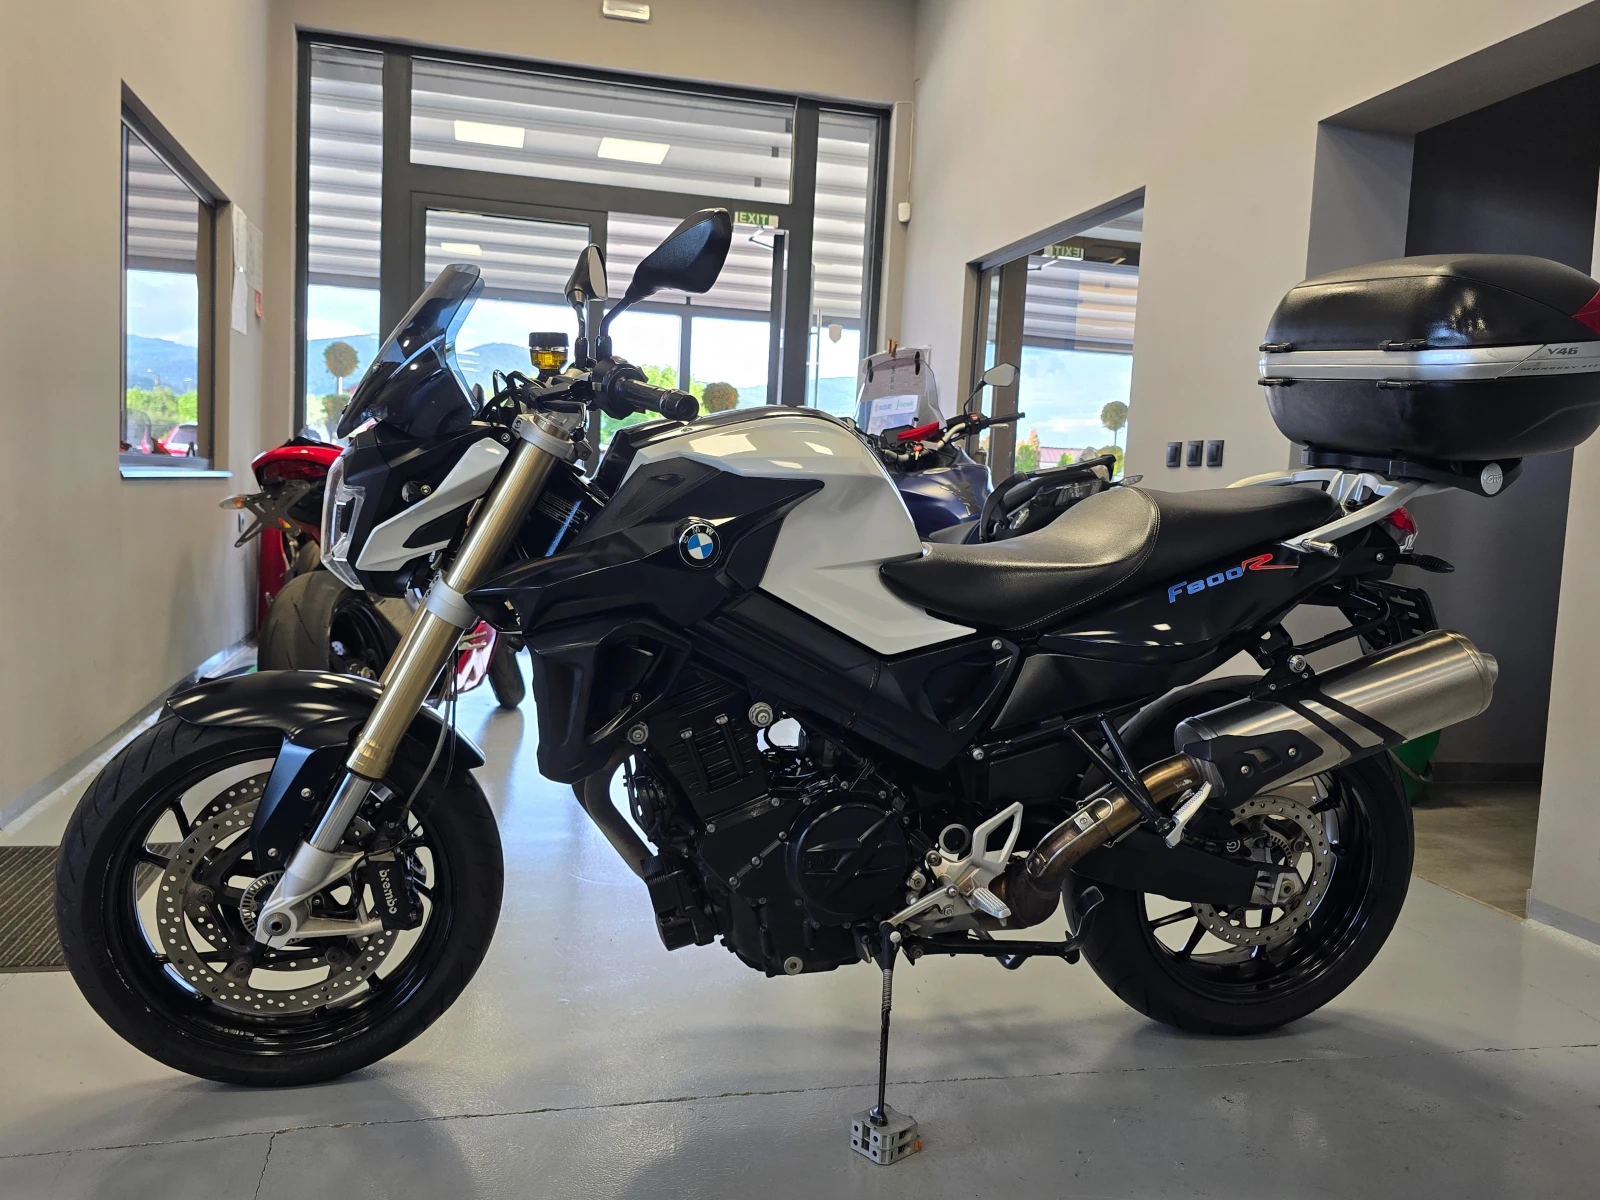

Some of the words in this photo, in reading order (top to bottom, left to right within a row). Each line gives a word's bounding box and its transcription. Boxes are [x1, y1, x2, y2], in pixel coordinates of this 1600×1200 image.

[740, 211, 768, 225] EXIT
[1548, 347, 1578, 355] V46
[682, 525, 715, 544] BMW
[379, 868, 398, 915] brembo
